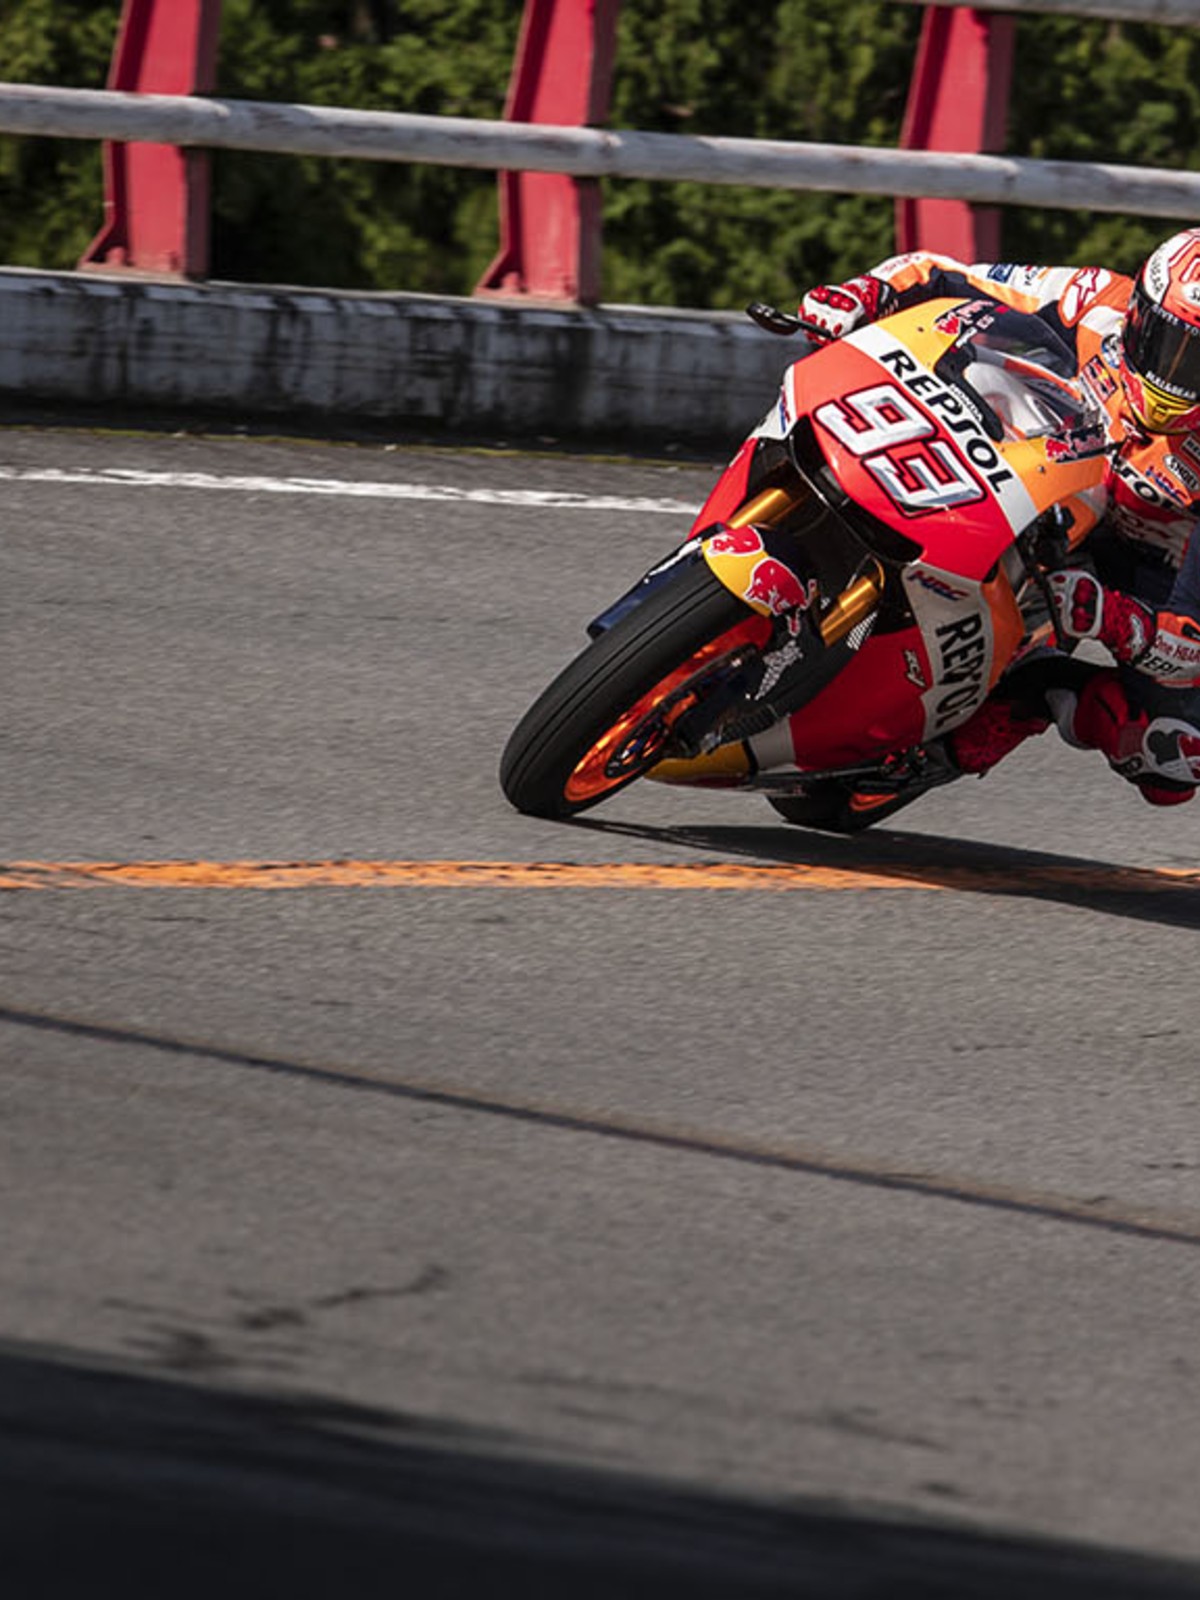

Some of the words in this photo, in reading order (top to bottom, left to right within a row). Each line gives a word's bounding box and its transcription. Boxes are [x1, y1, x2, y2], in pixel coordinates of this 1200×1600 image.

[813, 382, 988, 518] 93
[879, 349, 1013, 494] REPSOL
[1168, 456, 1199, 490] SHOEI
[907, 569, 971, 602] HRC
